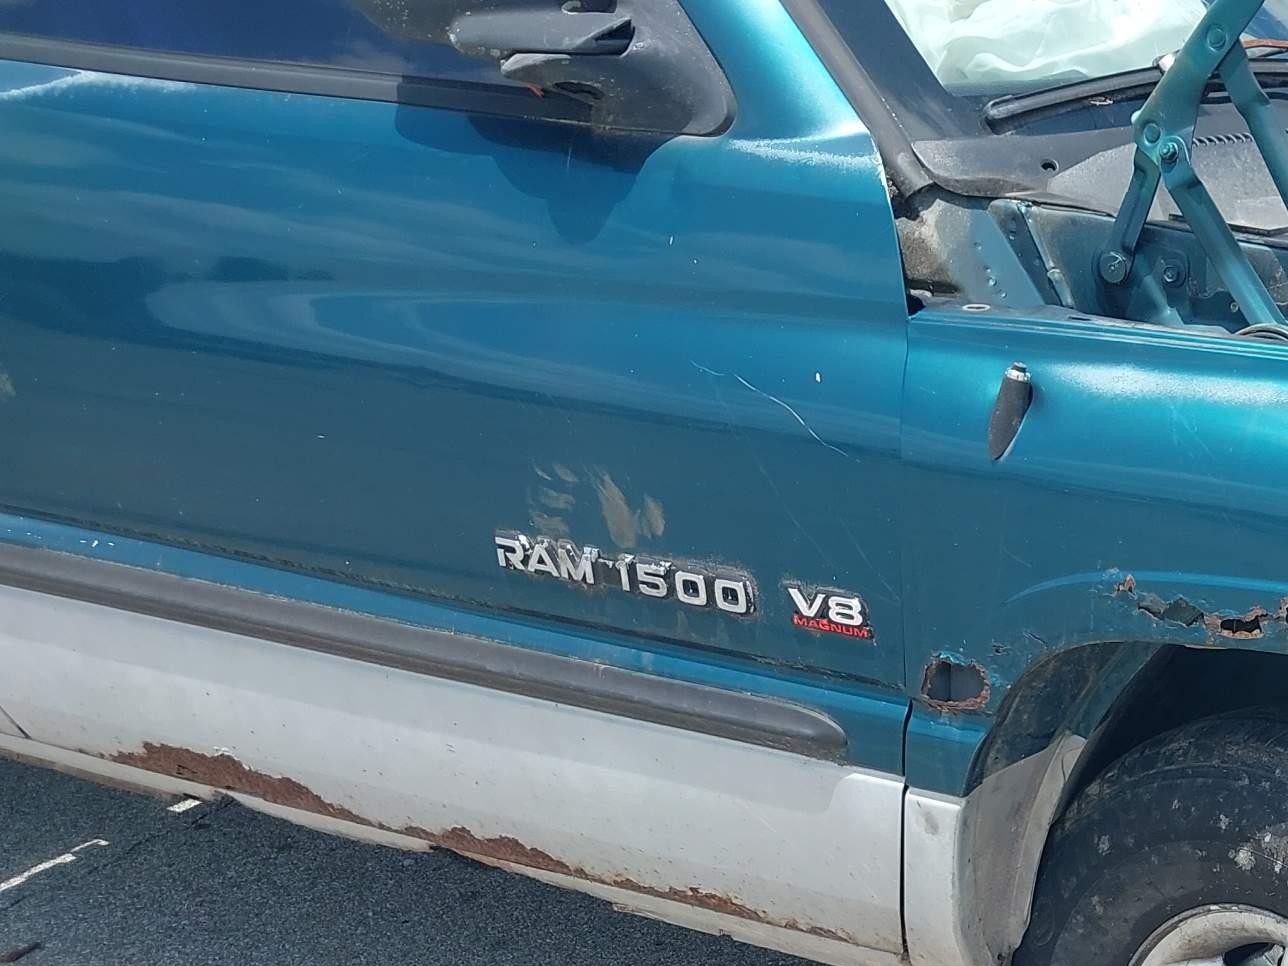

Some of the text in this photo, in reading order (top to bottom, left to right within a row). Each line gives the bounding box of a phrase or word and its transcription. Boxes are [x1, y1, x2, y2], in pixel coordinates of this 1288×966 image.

[495, 531, 756, 615] RAM 1500
[787, 586, 866, 626] V8
[791, 614, 871, 638] MAGNUM
